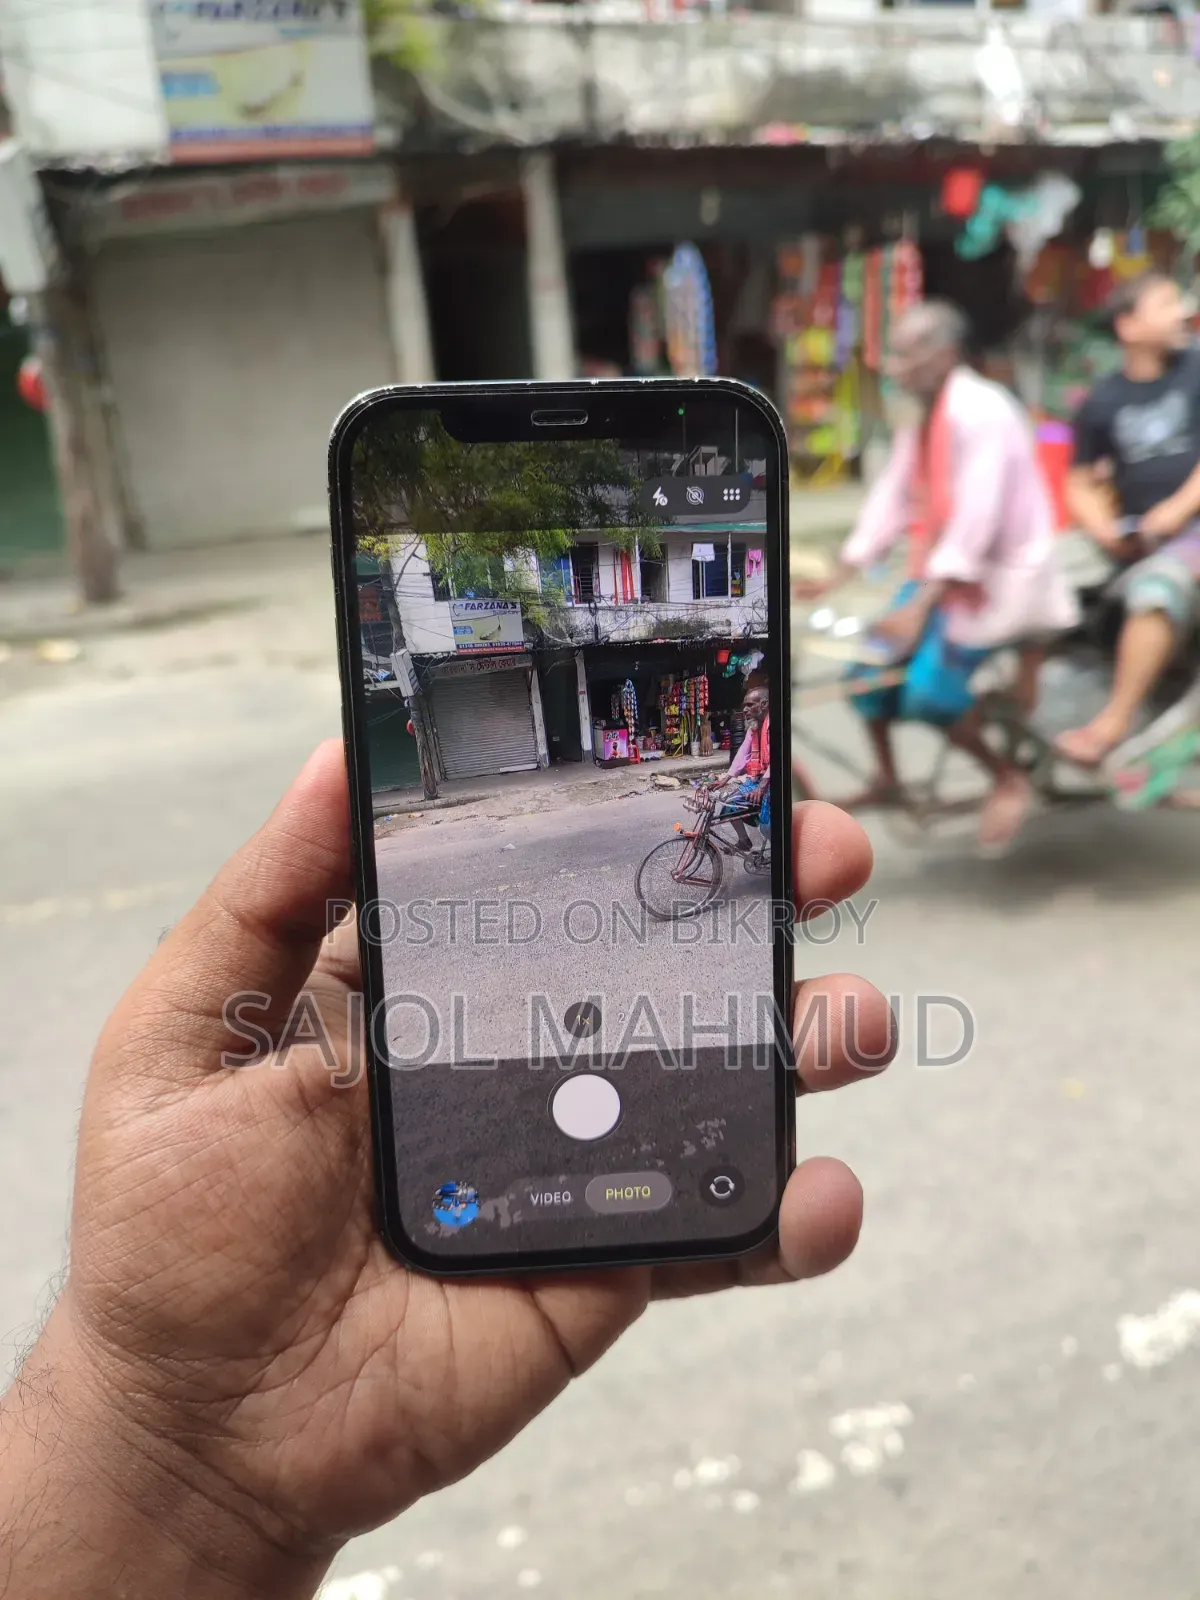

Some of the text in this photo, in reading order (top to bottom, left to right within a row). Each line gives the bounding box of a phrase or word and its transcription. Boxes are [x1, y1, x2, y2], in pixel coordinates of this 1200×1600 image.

[464, 602, 518, 611] FARZANA'S
[530, 1185, 651, 1206] VIDEO PHOTO
